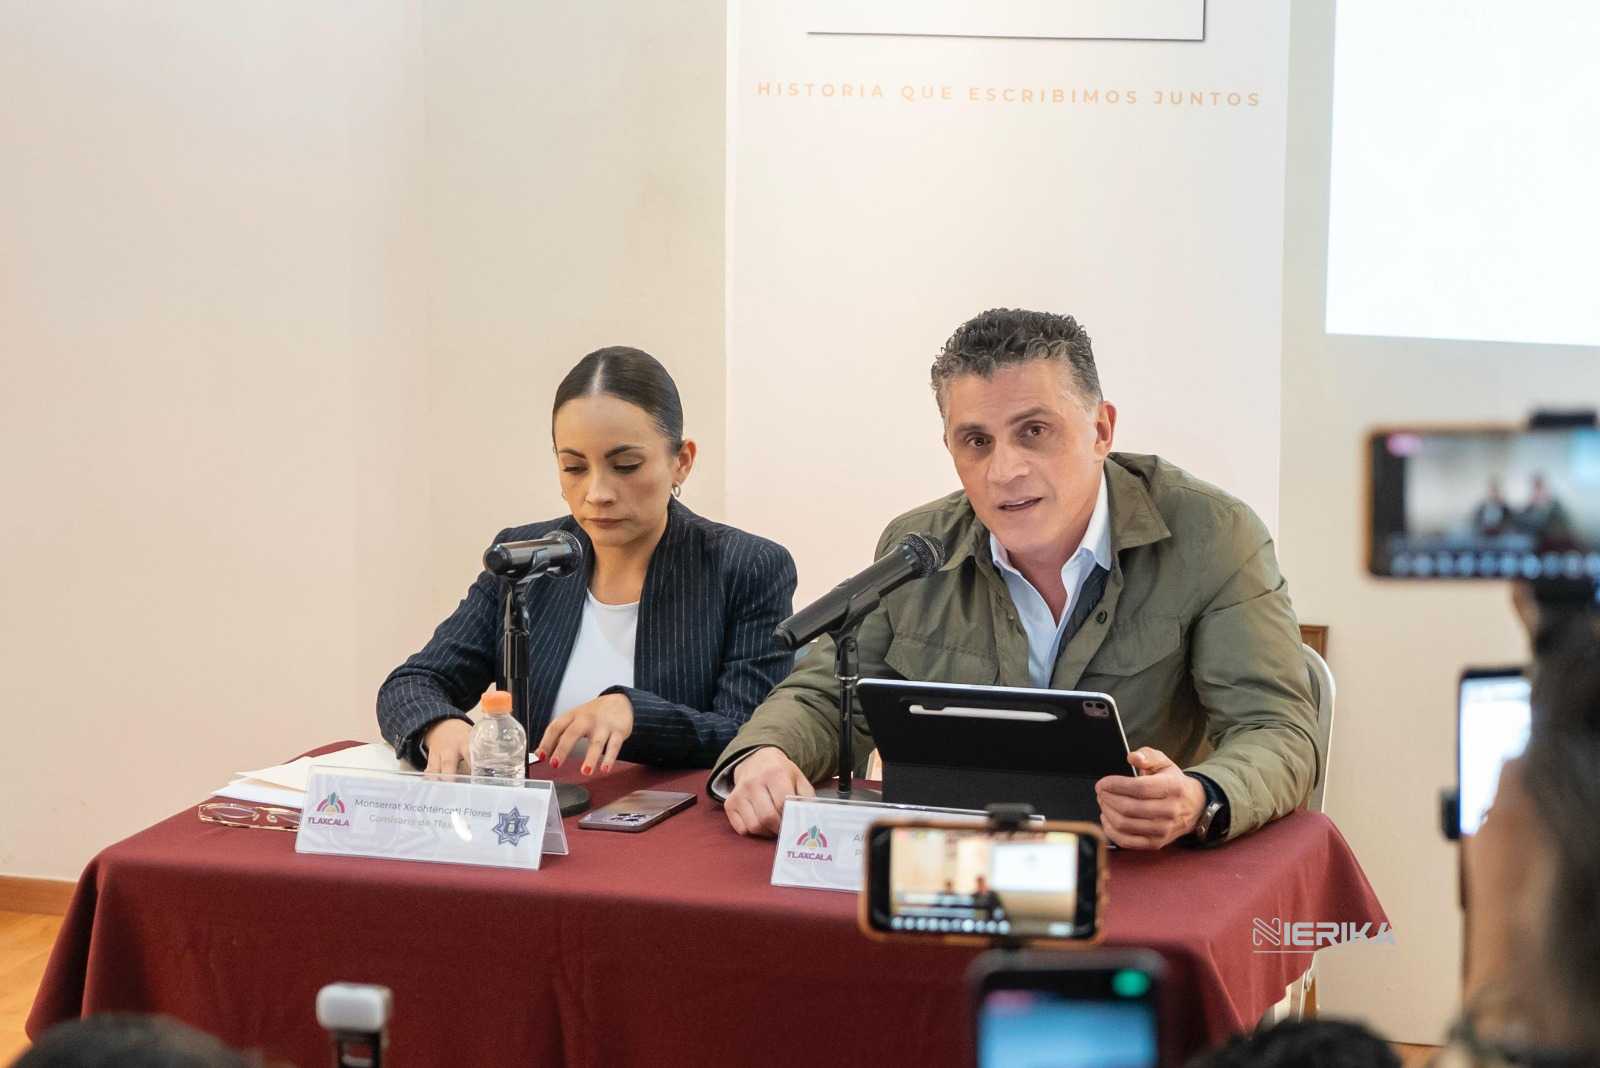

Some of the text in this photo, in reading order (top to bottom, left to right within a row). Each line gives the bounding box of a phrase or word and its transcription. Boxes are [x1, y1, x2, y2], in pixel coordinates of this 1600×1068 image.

[757, 81, 1261, 107] HISTORIA QUE ESCRIBIMOS JUNTOS
[463, 807, 492, 818] Flores
[307, 816, 350, 827] TLAXCALA
[786, 850, 833, 862] TLAXCALA
